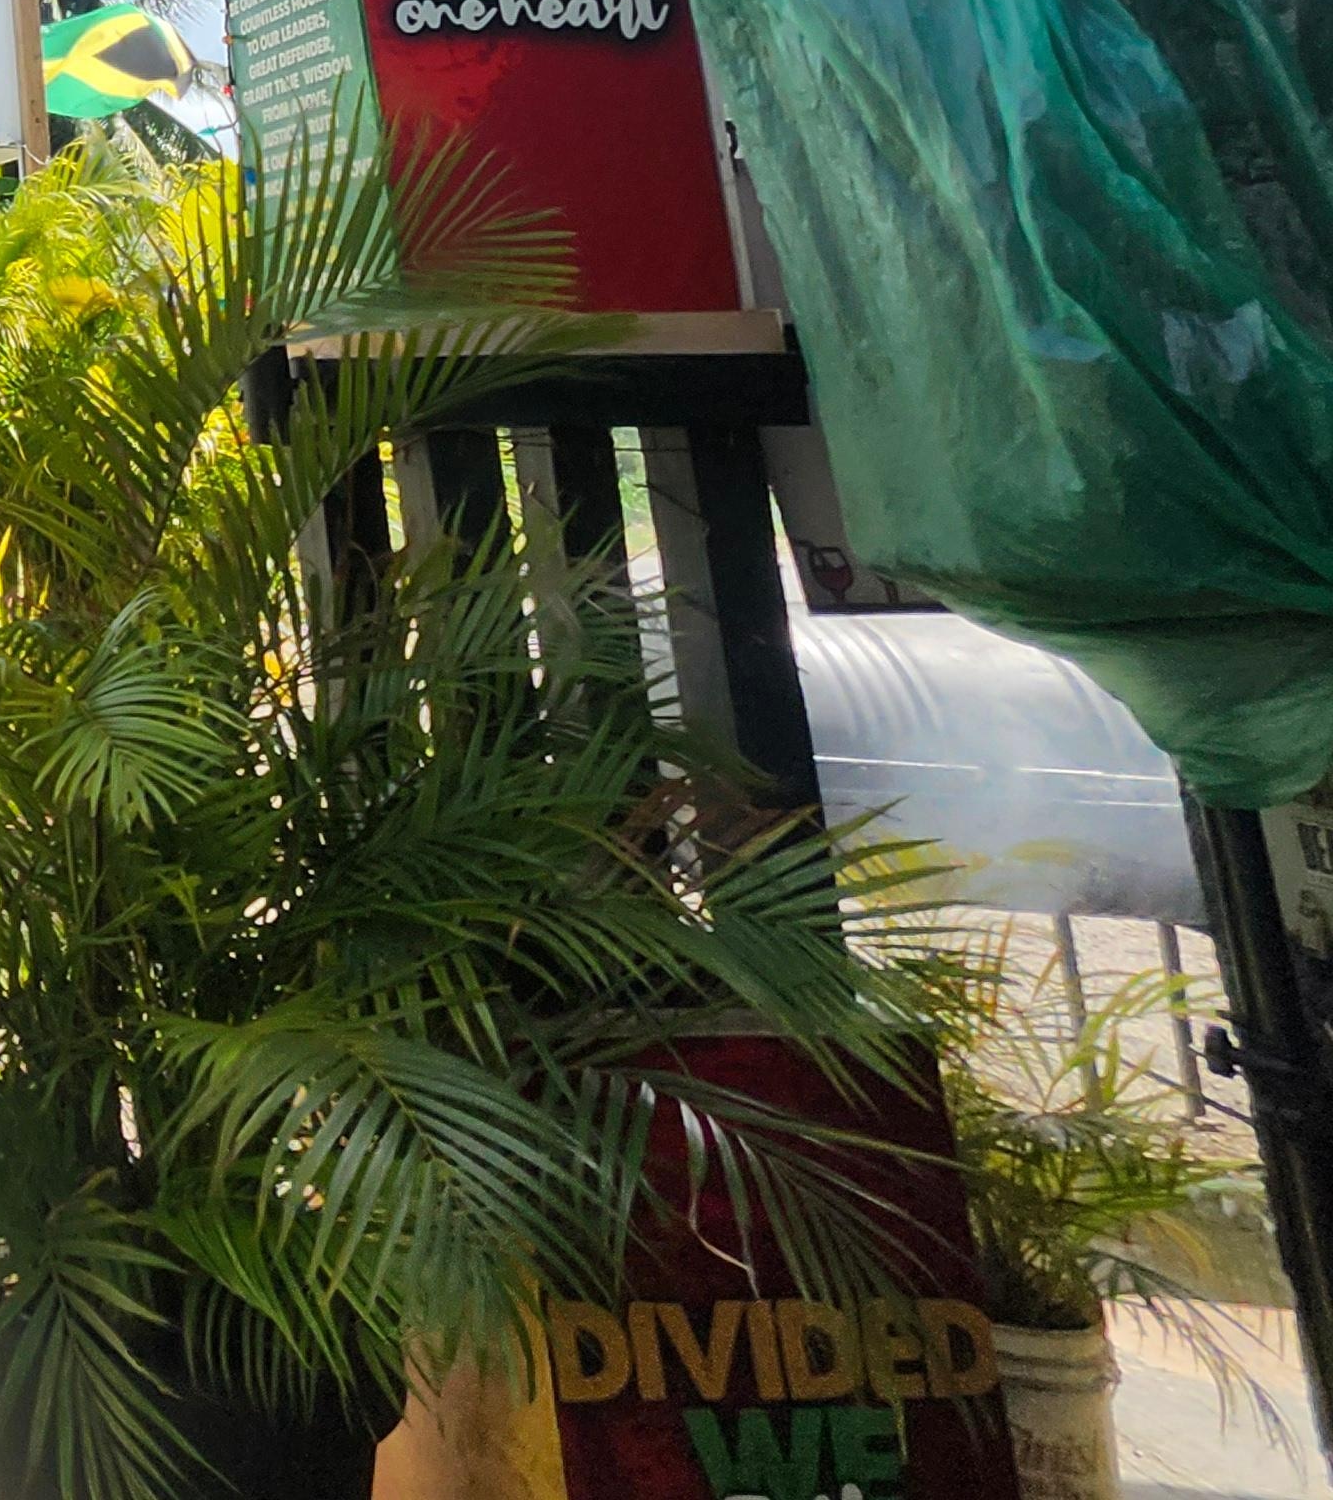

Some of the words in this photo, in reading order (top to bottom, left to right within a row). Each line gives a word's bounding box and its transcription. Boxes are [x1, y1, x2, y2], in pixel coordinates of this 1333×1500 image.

[246, 38, 260, 57] TO
[259, 30, 281, 52] OUR
[281, 10, 330, 43] LEADERS,
[249, 55, 278, 81] GREAT
[278, 35, 335, 69] DEFENDER,
[544, 1299, 1001, 1402] DIVIDED
[682, 1406, 905, 1500] WE
